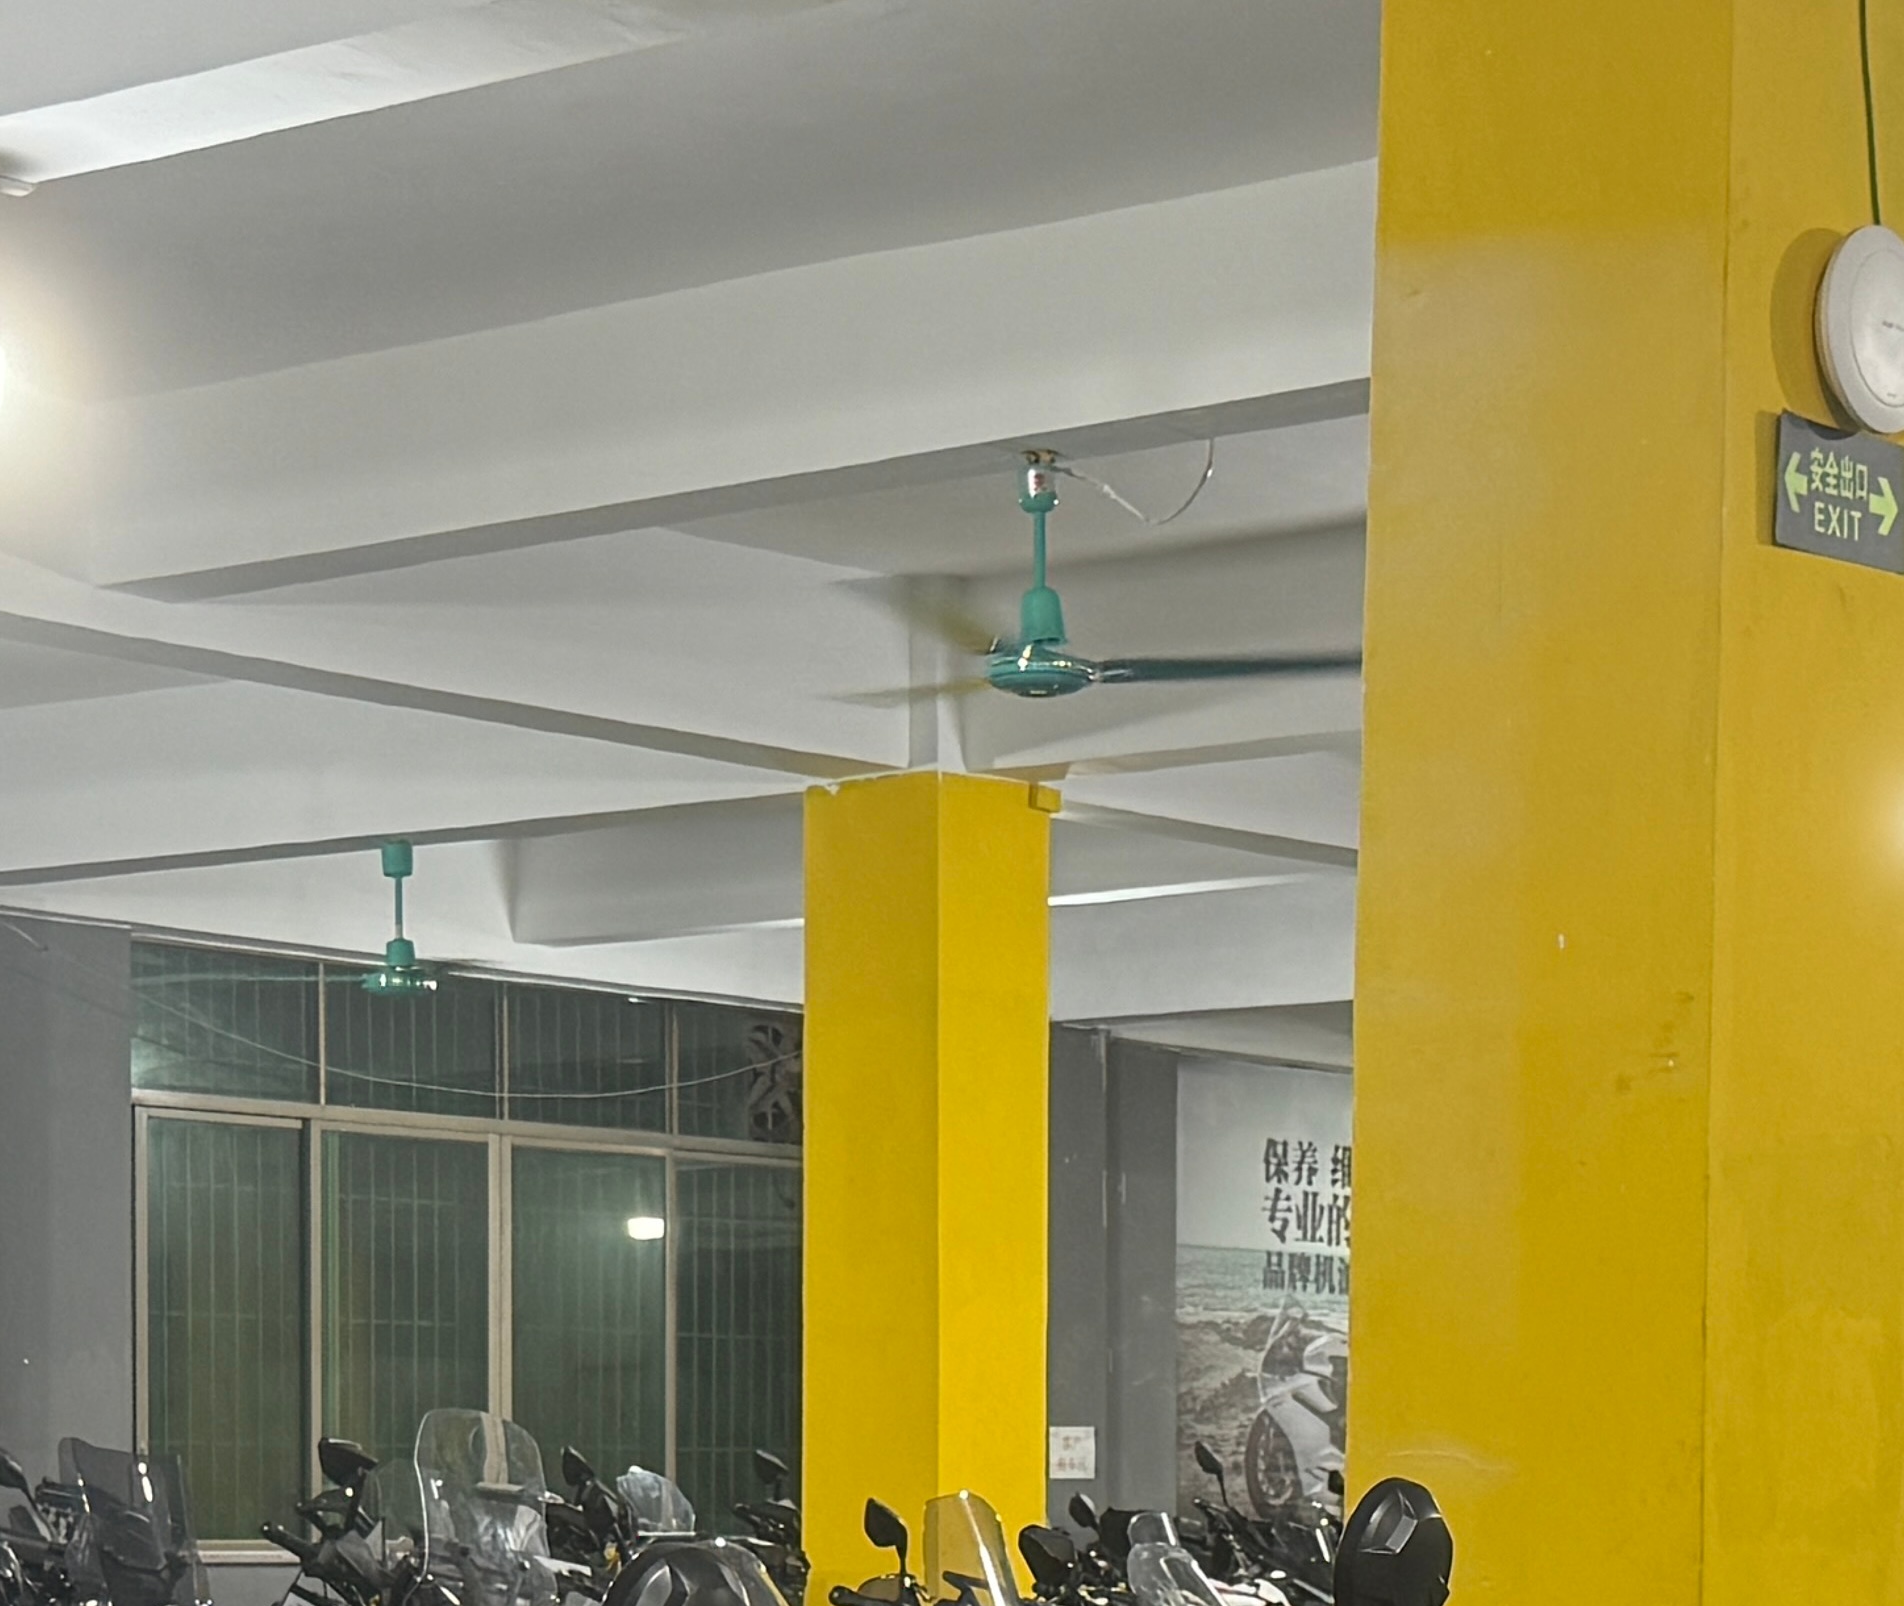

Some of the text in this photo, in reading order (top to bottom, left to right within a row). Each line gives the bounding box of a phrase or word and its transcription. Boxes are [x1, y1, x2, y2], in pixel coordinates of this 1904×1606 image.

[1810, 448, 1869, 500] 安全出口
[1814, 501, 1862, 541] EXIT
[1264, 1138, 1318, 1186] 保养
